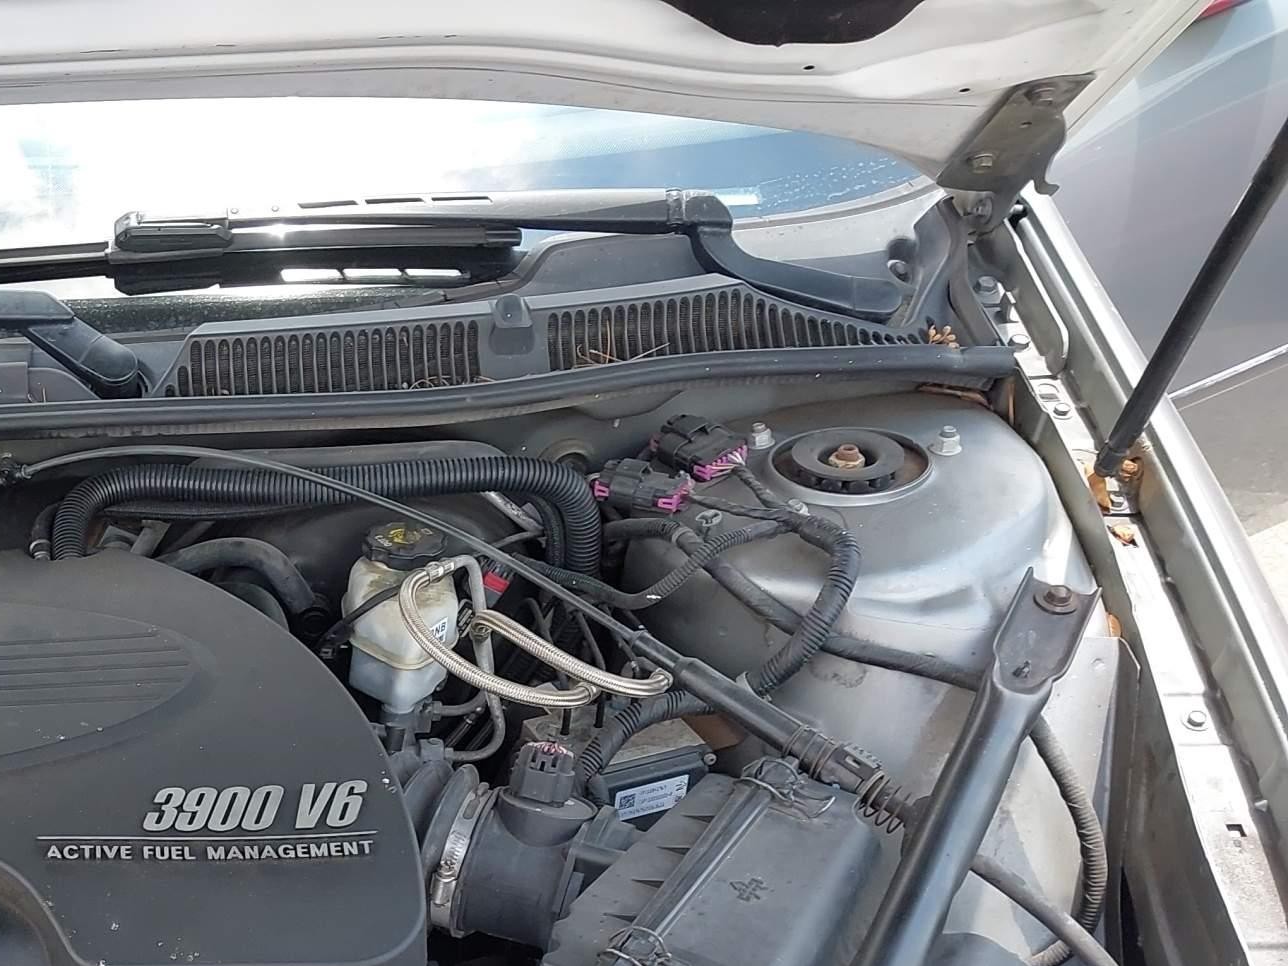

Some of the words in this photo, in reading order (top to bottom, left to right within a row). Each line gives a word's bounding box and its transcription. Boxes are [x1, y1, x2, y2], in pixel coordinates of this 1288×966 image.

[143, 785, 284, 831] 3900
[296, 780, 368, 828] V6
[47, 845, 132, 859] ACTIVE
[143, 845, 196, 860] FUEL
[207, 841, 373, 859] MANAGEMENT
